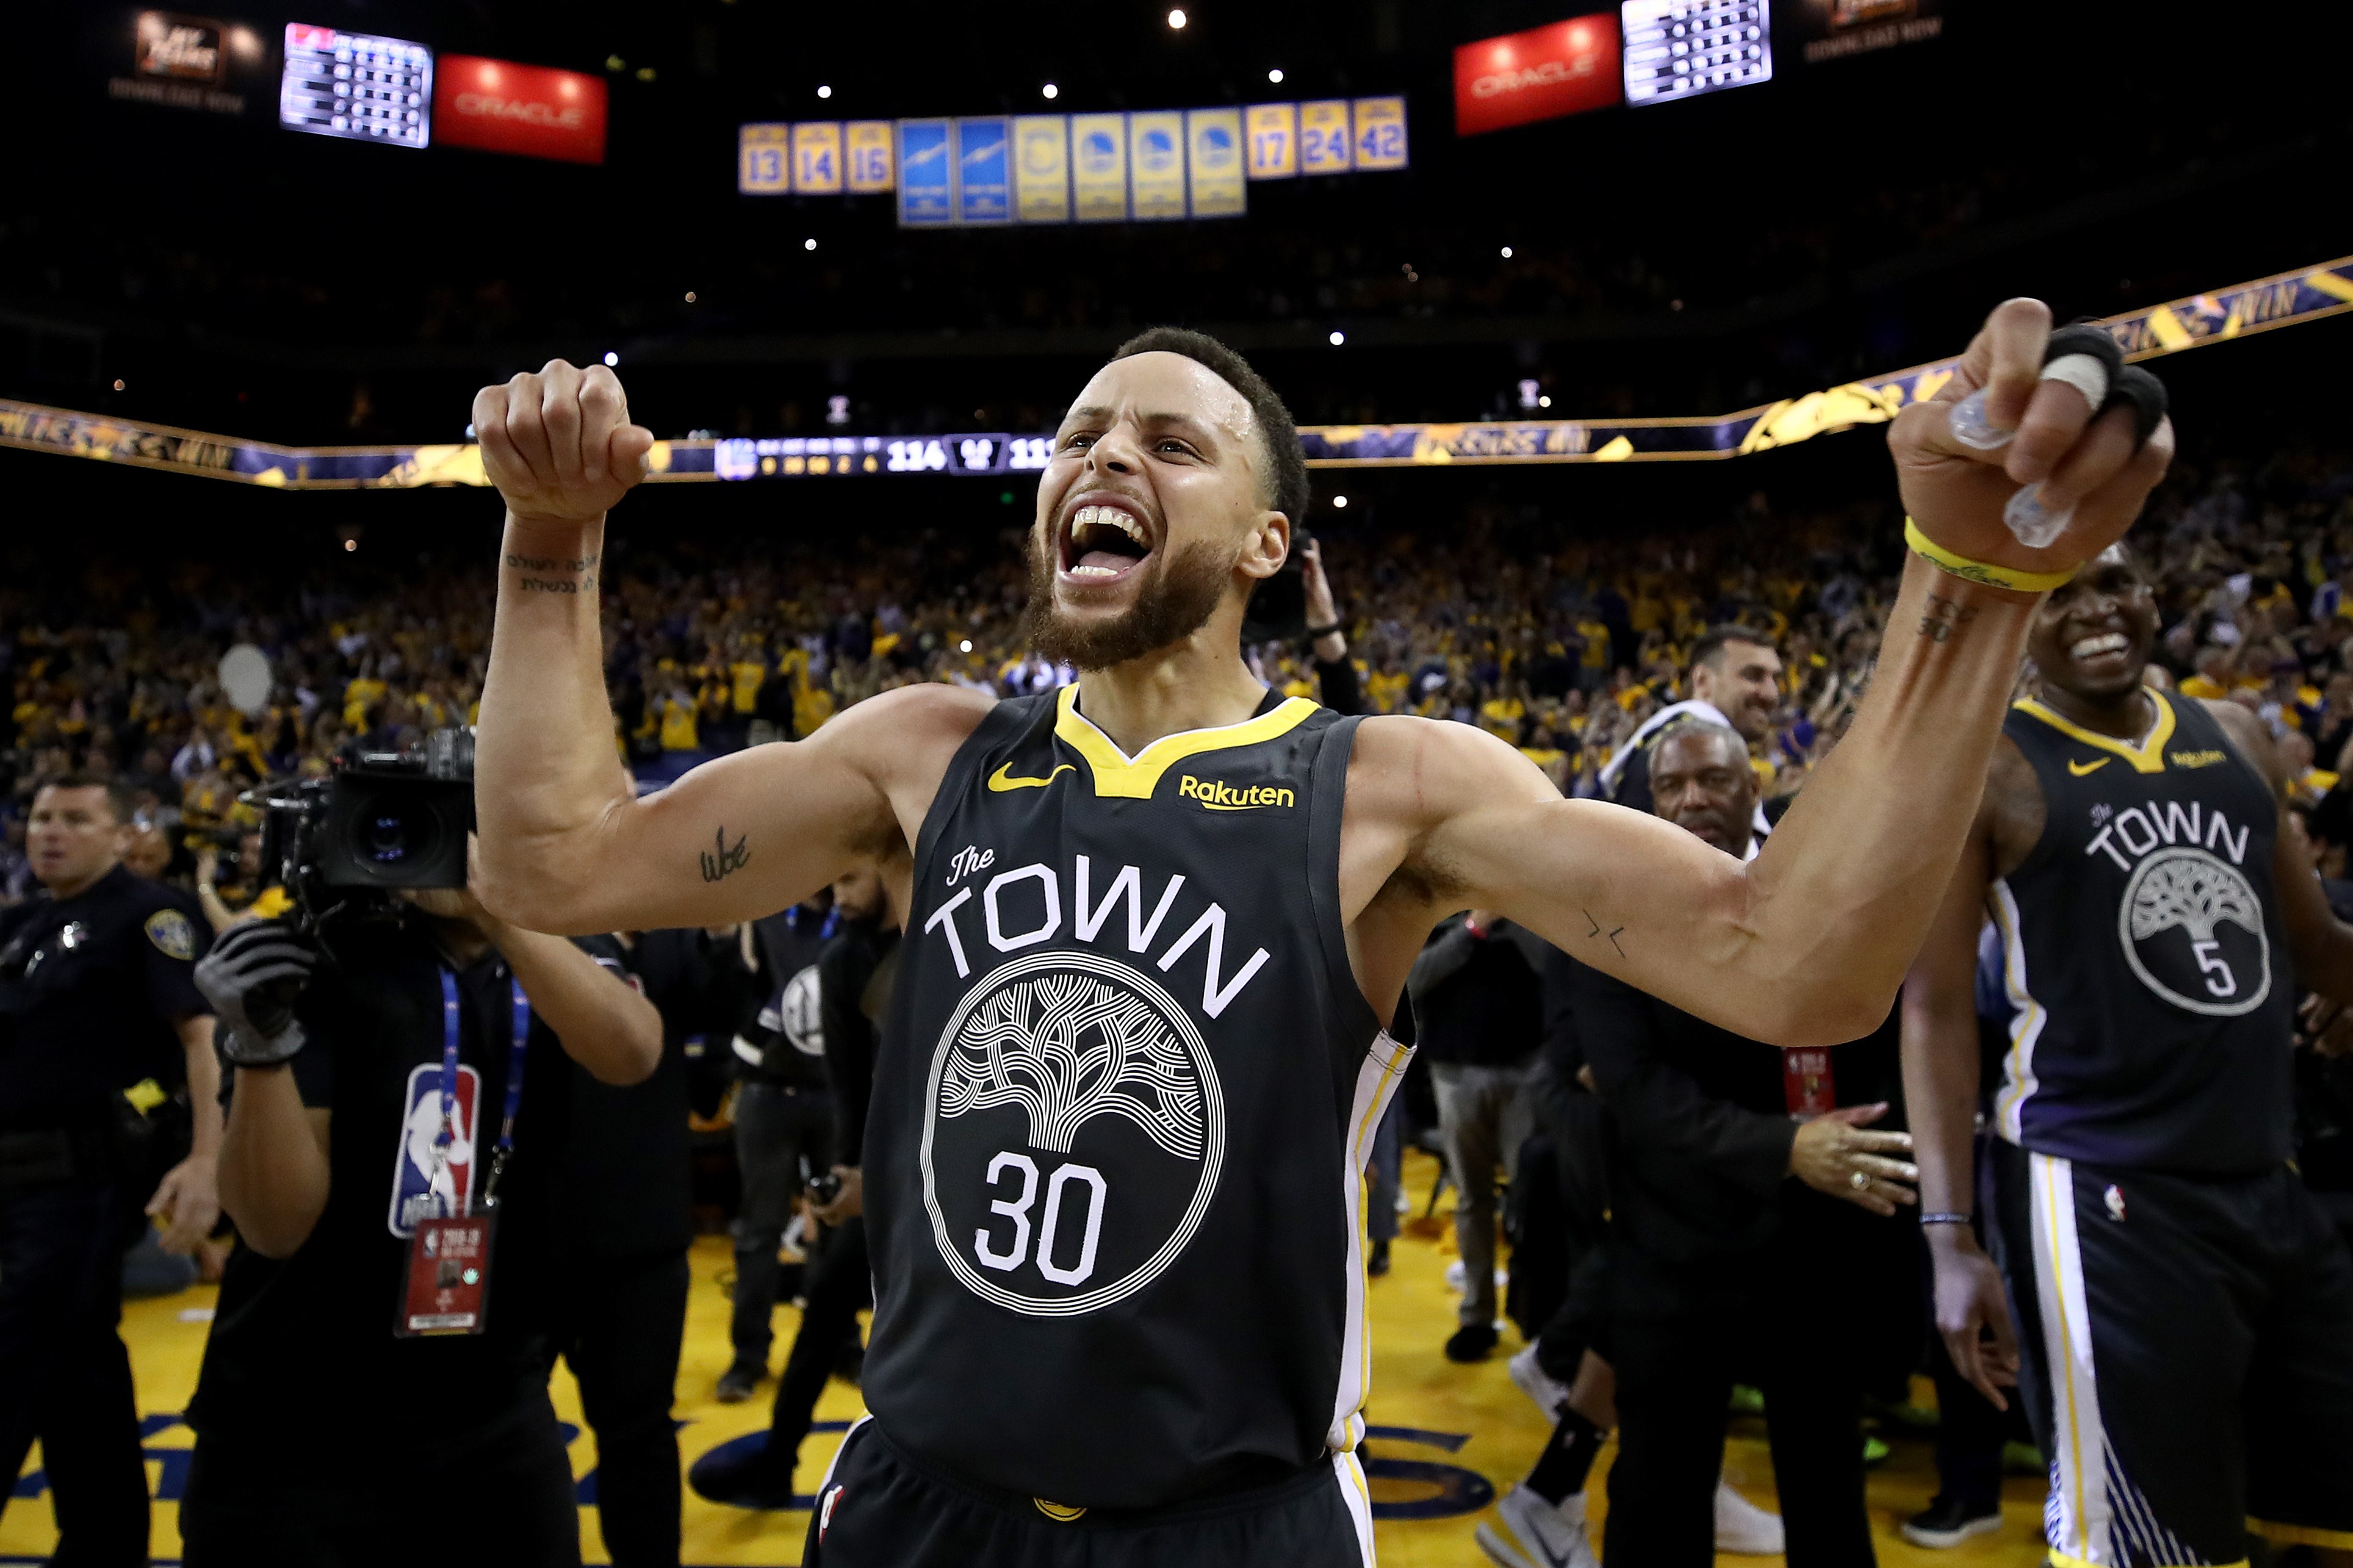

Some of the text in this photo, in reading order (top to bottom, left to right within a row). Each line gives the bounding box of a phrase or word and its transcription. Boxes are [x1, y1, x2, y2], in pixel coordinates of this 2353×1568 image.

[1471, 54, 1597, 99] ORACLE
[455, 93, 584, 130] ORACLE
[1256, 131, 1286, 168] 17
[1305, 126, 1346, 164] 24
[1361, 123, 1402, 158] 42
[749, 148, 782, 182] 13
[804, 149, 833, 182] 14
[855, 147, 887, 182] 16
[887, 440, 947, 472] 114
[1179, 775, 1294, 810] Rakuten
[2085, 799, 2250, 872] TOWN
[946, 844, 995, 886] The
[924, 854, 1270, 1020] TOWN
[2191, 940, 2238, 998] 5
[974, 1151, 1108, 1287] 30
